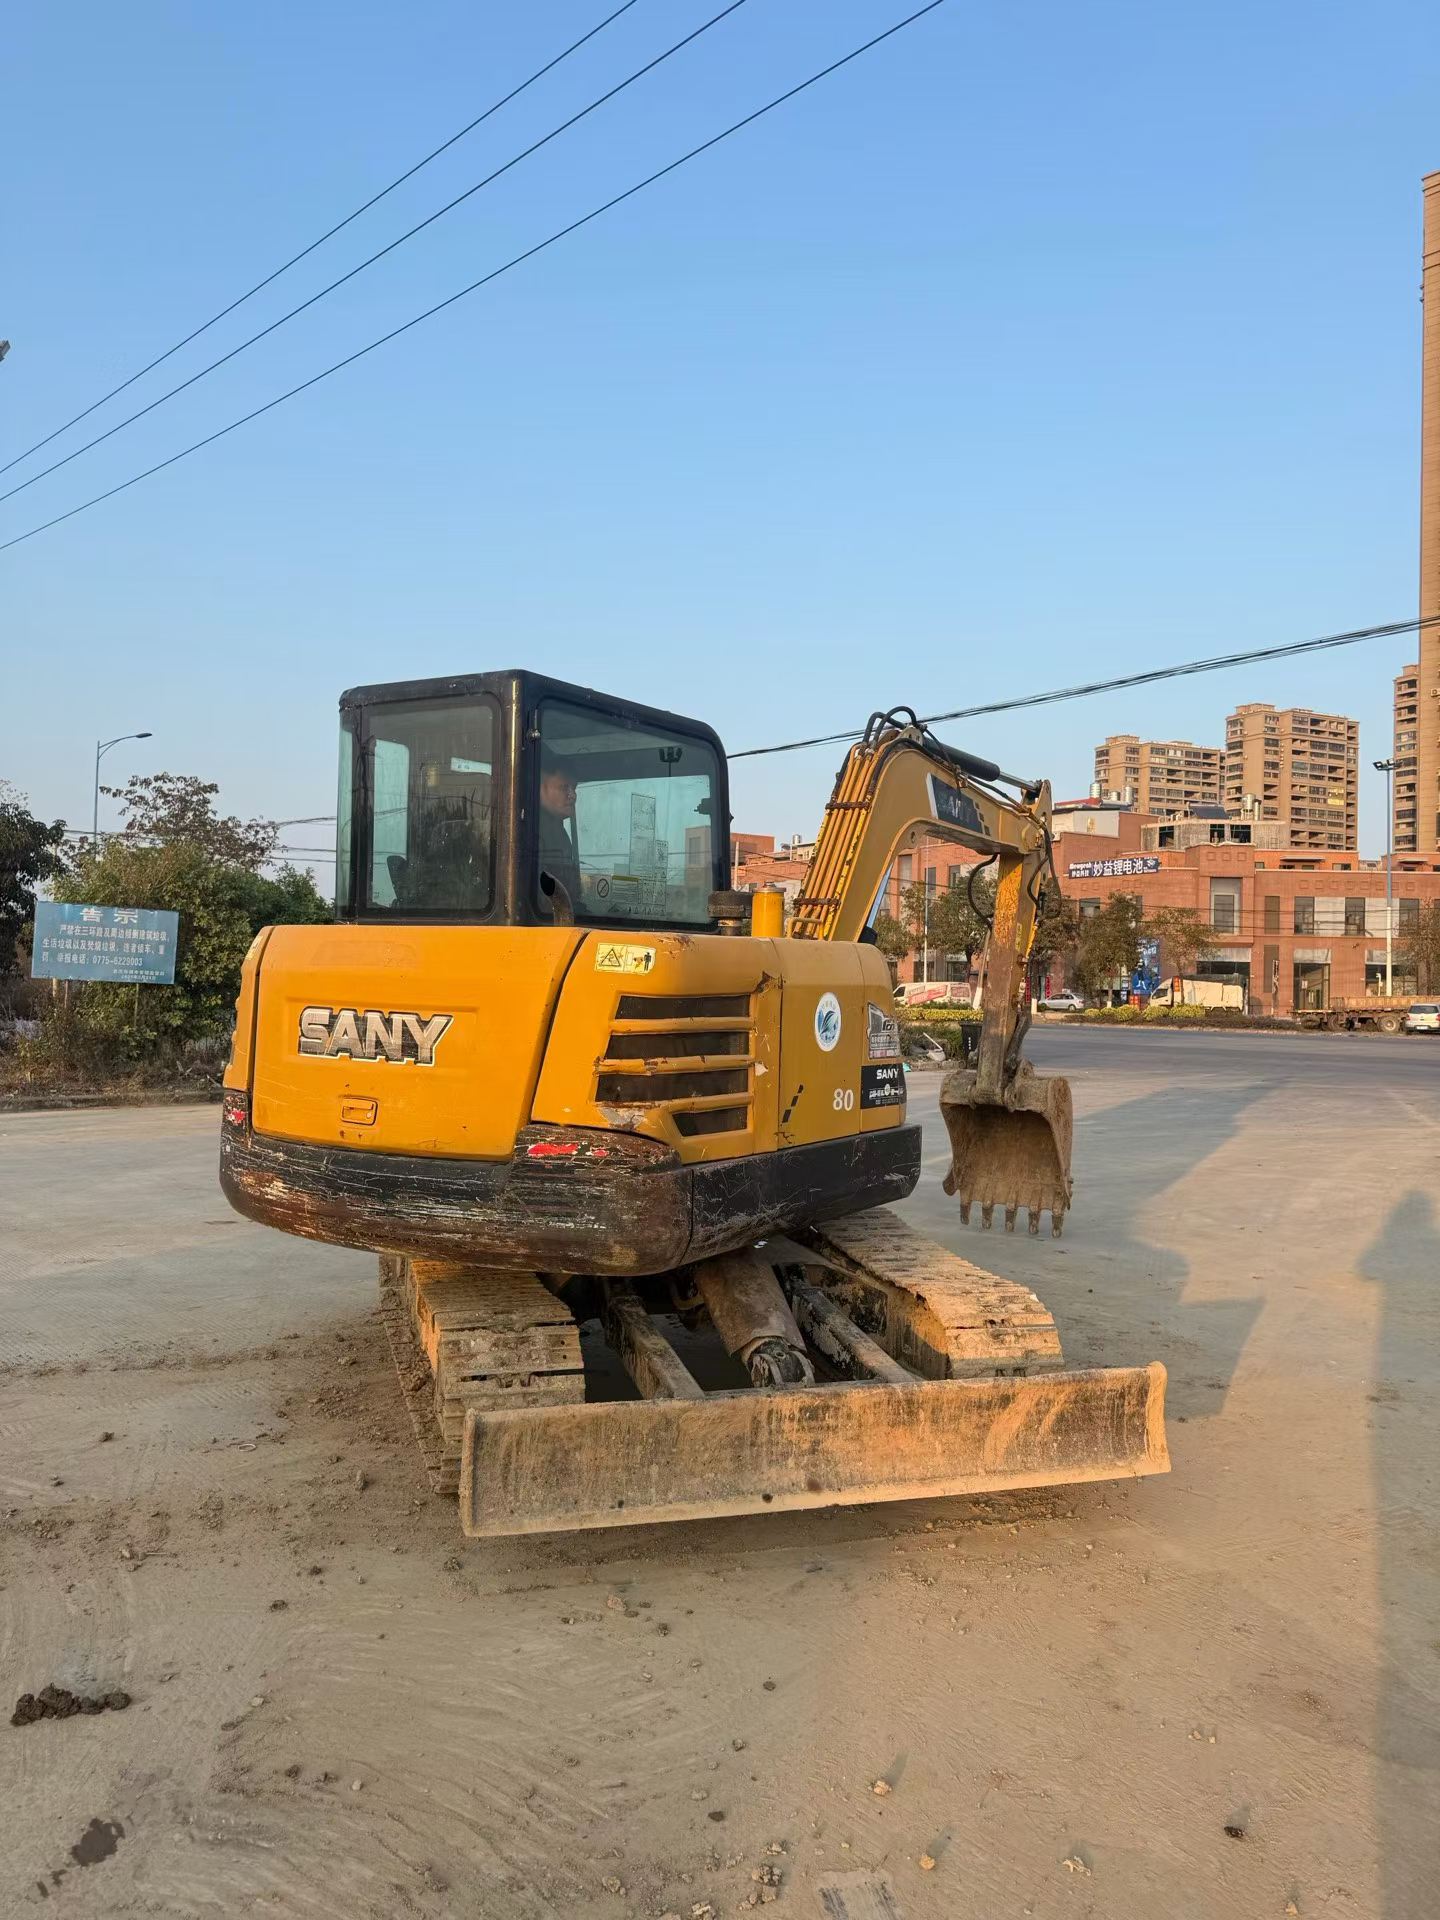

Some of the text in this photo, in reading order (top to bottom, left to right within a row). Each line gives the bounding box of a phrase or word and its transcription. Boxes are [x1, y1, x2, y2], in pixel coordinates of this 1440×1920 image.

[1093, 858, 1143, 877] 妙益锂电池
[298, 1005, 454, 1067] SANY
[876, 1068, 899, 1080] SANY
[832, 1088, 854, 1111] 80
